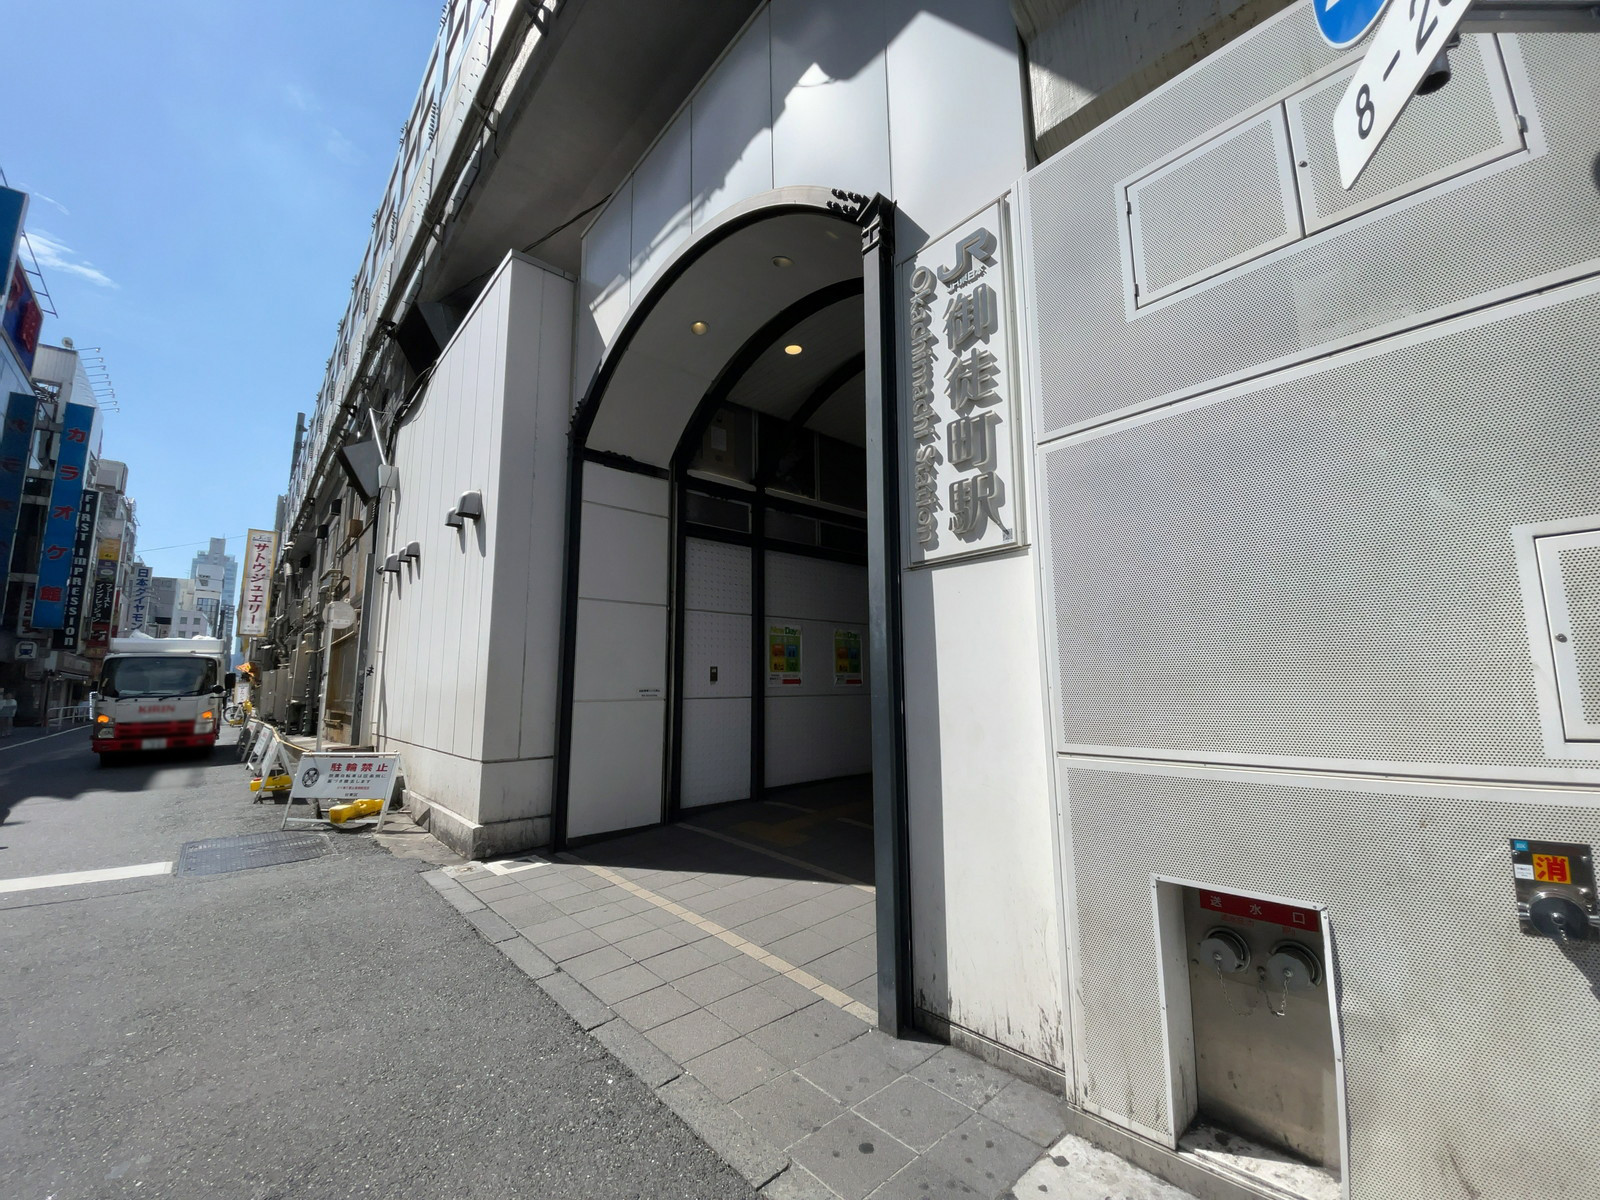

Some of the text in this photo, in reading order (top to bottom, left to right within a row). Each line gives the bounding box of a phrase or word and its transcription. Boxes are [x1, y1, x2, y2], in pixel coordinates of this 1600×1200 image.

[910, 266, 937, 543] Okachimachi Station
[40, 428, 86, 602] カラオケ館
[80, 495, 94, 540] FIRST
[248, 543, 269, 624] サトウジュエリー
[138, 704, 176, 714] KIRIN
[330, 763, 389, 772] 駐輪禁止
[1536, 855, 1568, 882] 消
[1210, 895, 1306, 924] 送水口
